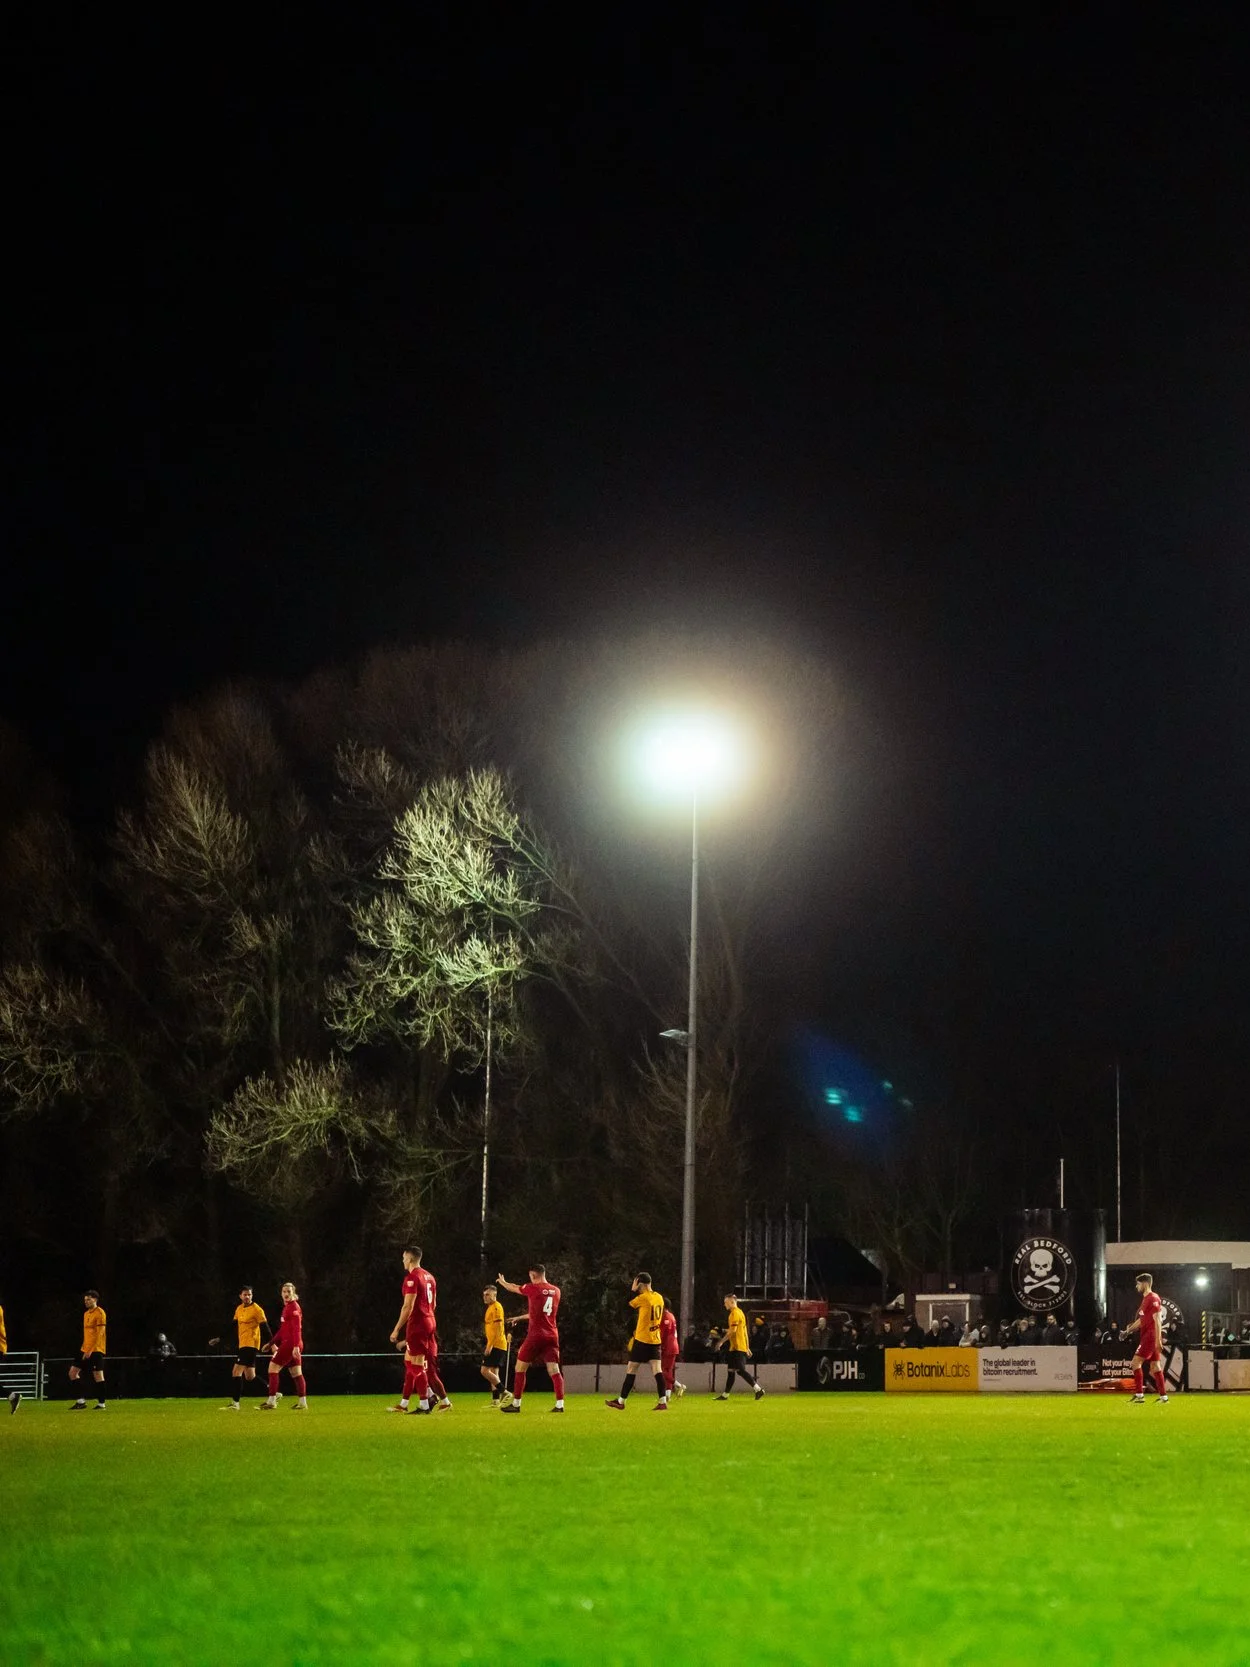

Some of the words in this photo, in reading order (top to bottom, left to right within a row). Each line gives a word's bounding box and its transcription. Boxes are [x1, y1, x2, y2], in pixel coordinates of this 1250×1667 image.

[1014, 1244, 1031, 1265] REAL
[1033, 1240, 1072, 1265] BEDFORD
[426, 1282, 433, 1304] 6
[542, 1296, 553, 1316] 4
[650, 1305, 662, 1321] 10
[1161, 1299, 1181, 1317] DFORD
[832, 1360, 859, 1380] PJH
[906, 1361, 971, 1378] BotanixLabs
[982, 1358, 994, 1367] The
[994, 1358, 1011, 1369] global
[1012, 1358, 1030, 1367] leader
[1031, 1358, 1036, 1367] in
[983, 1368, 1002, 1376] bitcoin
[1003, 1367, 1038, 1376] recruitment.
[1102, 1359, 1112, 1367] Not
[1112, 1360, 1123, 1368] your
[1123, 1359, 1132, 1368] key
